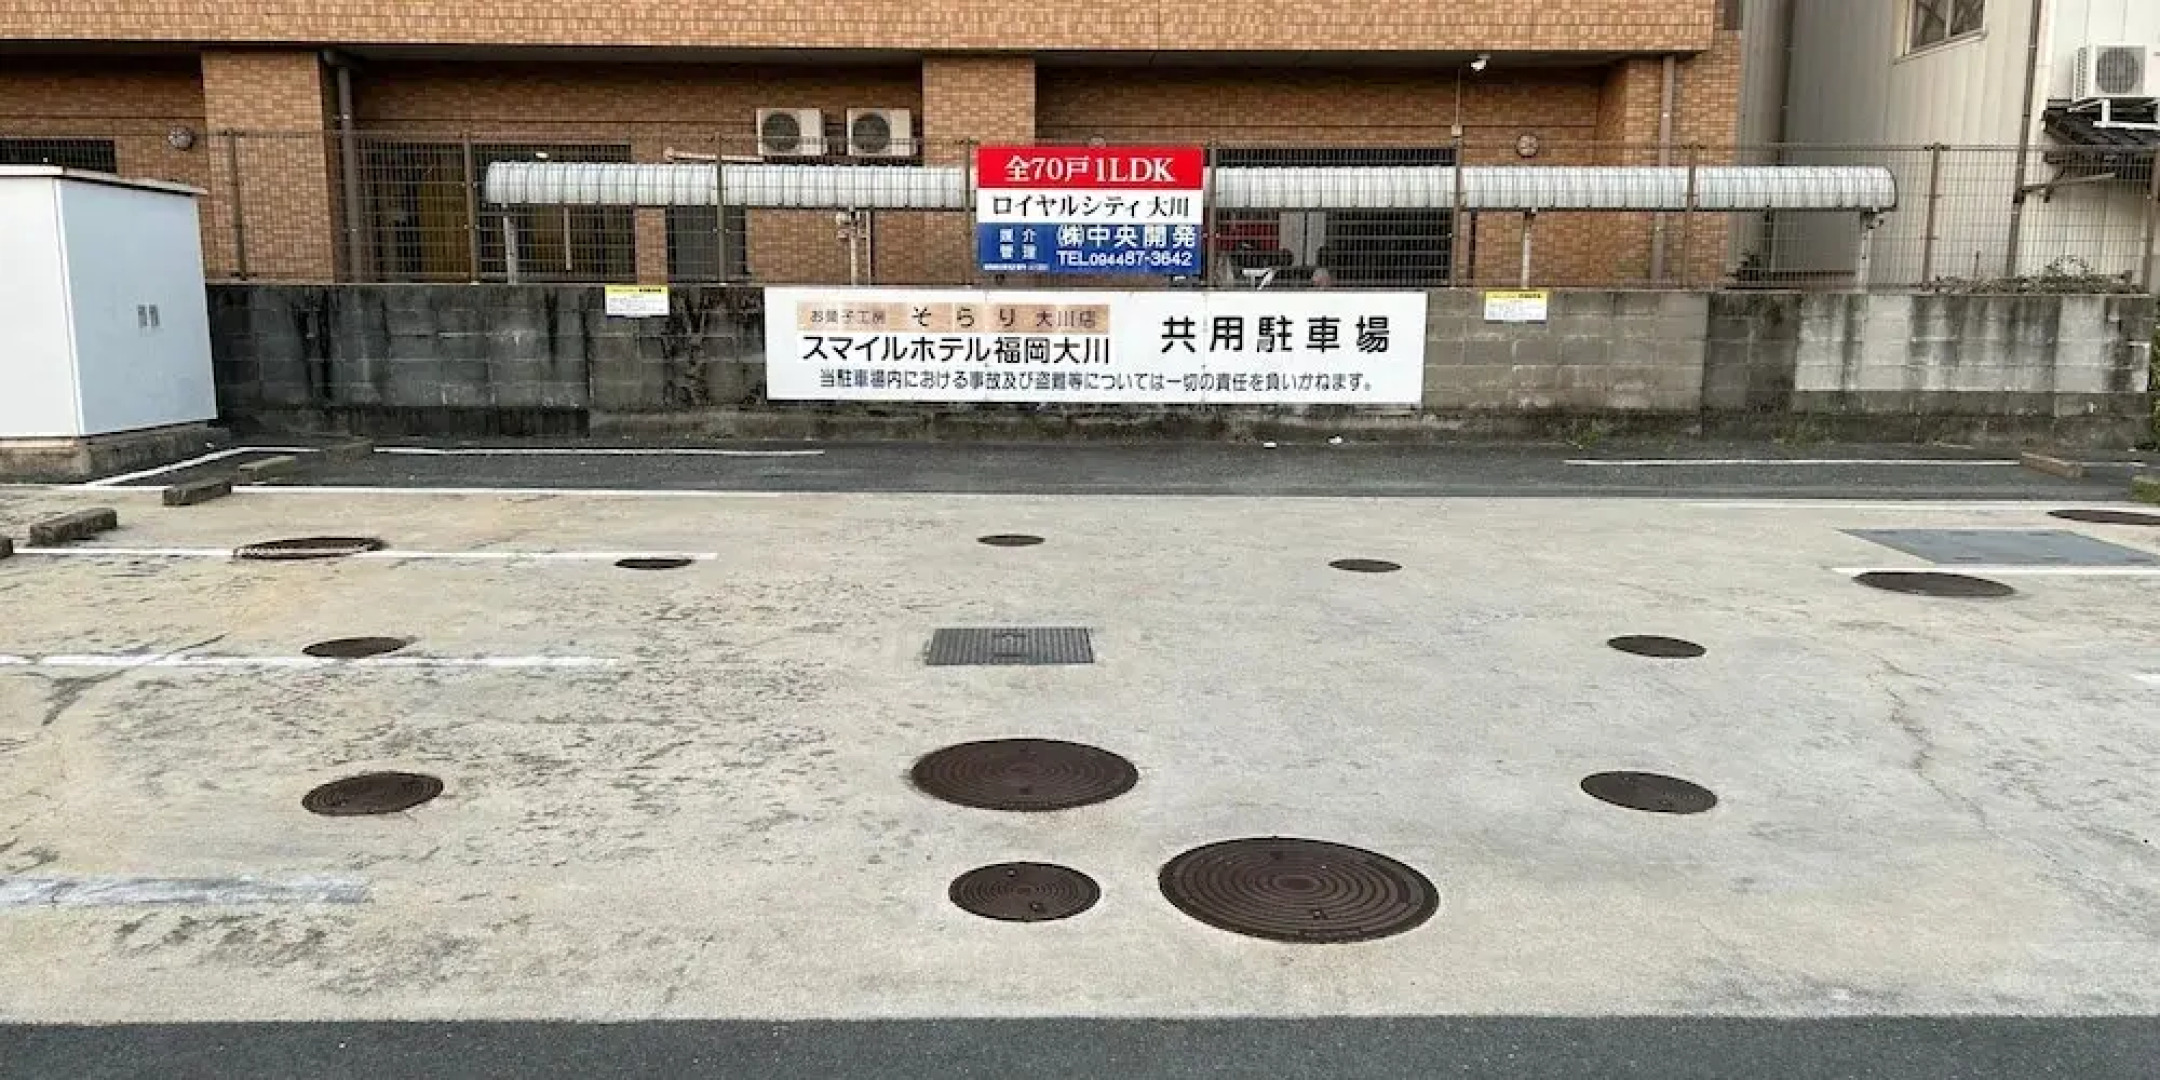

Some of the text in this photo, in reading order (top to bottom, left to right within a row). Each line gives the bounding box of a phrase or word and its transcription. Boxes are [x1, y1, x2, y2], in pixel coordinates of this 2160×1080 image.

[1004, 155, 1176, 182] 全70戸 1LDK
[992, 194, 1189, 219] ロイヤルシティ大川
[911, 306, 1016, 327] そらり
[1036, 309, 1096, 328] 大川店
[1161, 315, 1390, 353] 共用駐車場
[802, 336, 1110, 364] スマイルホテル福岡大川
